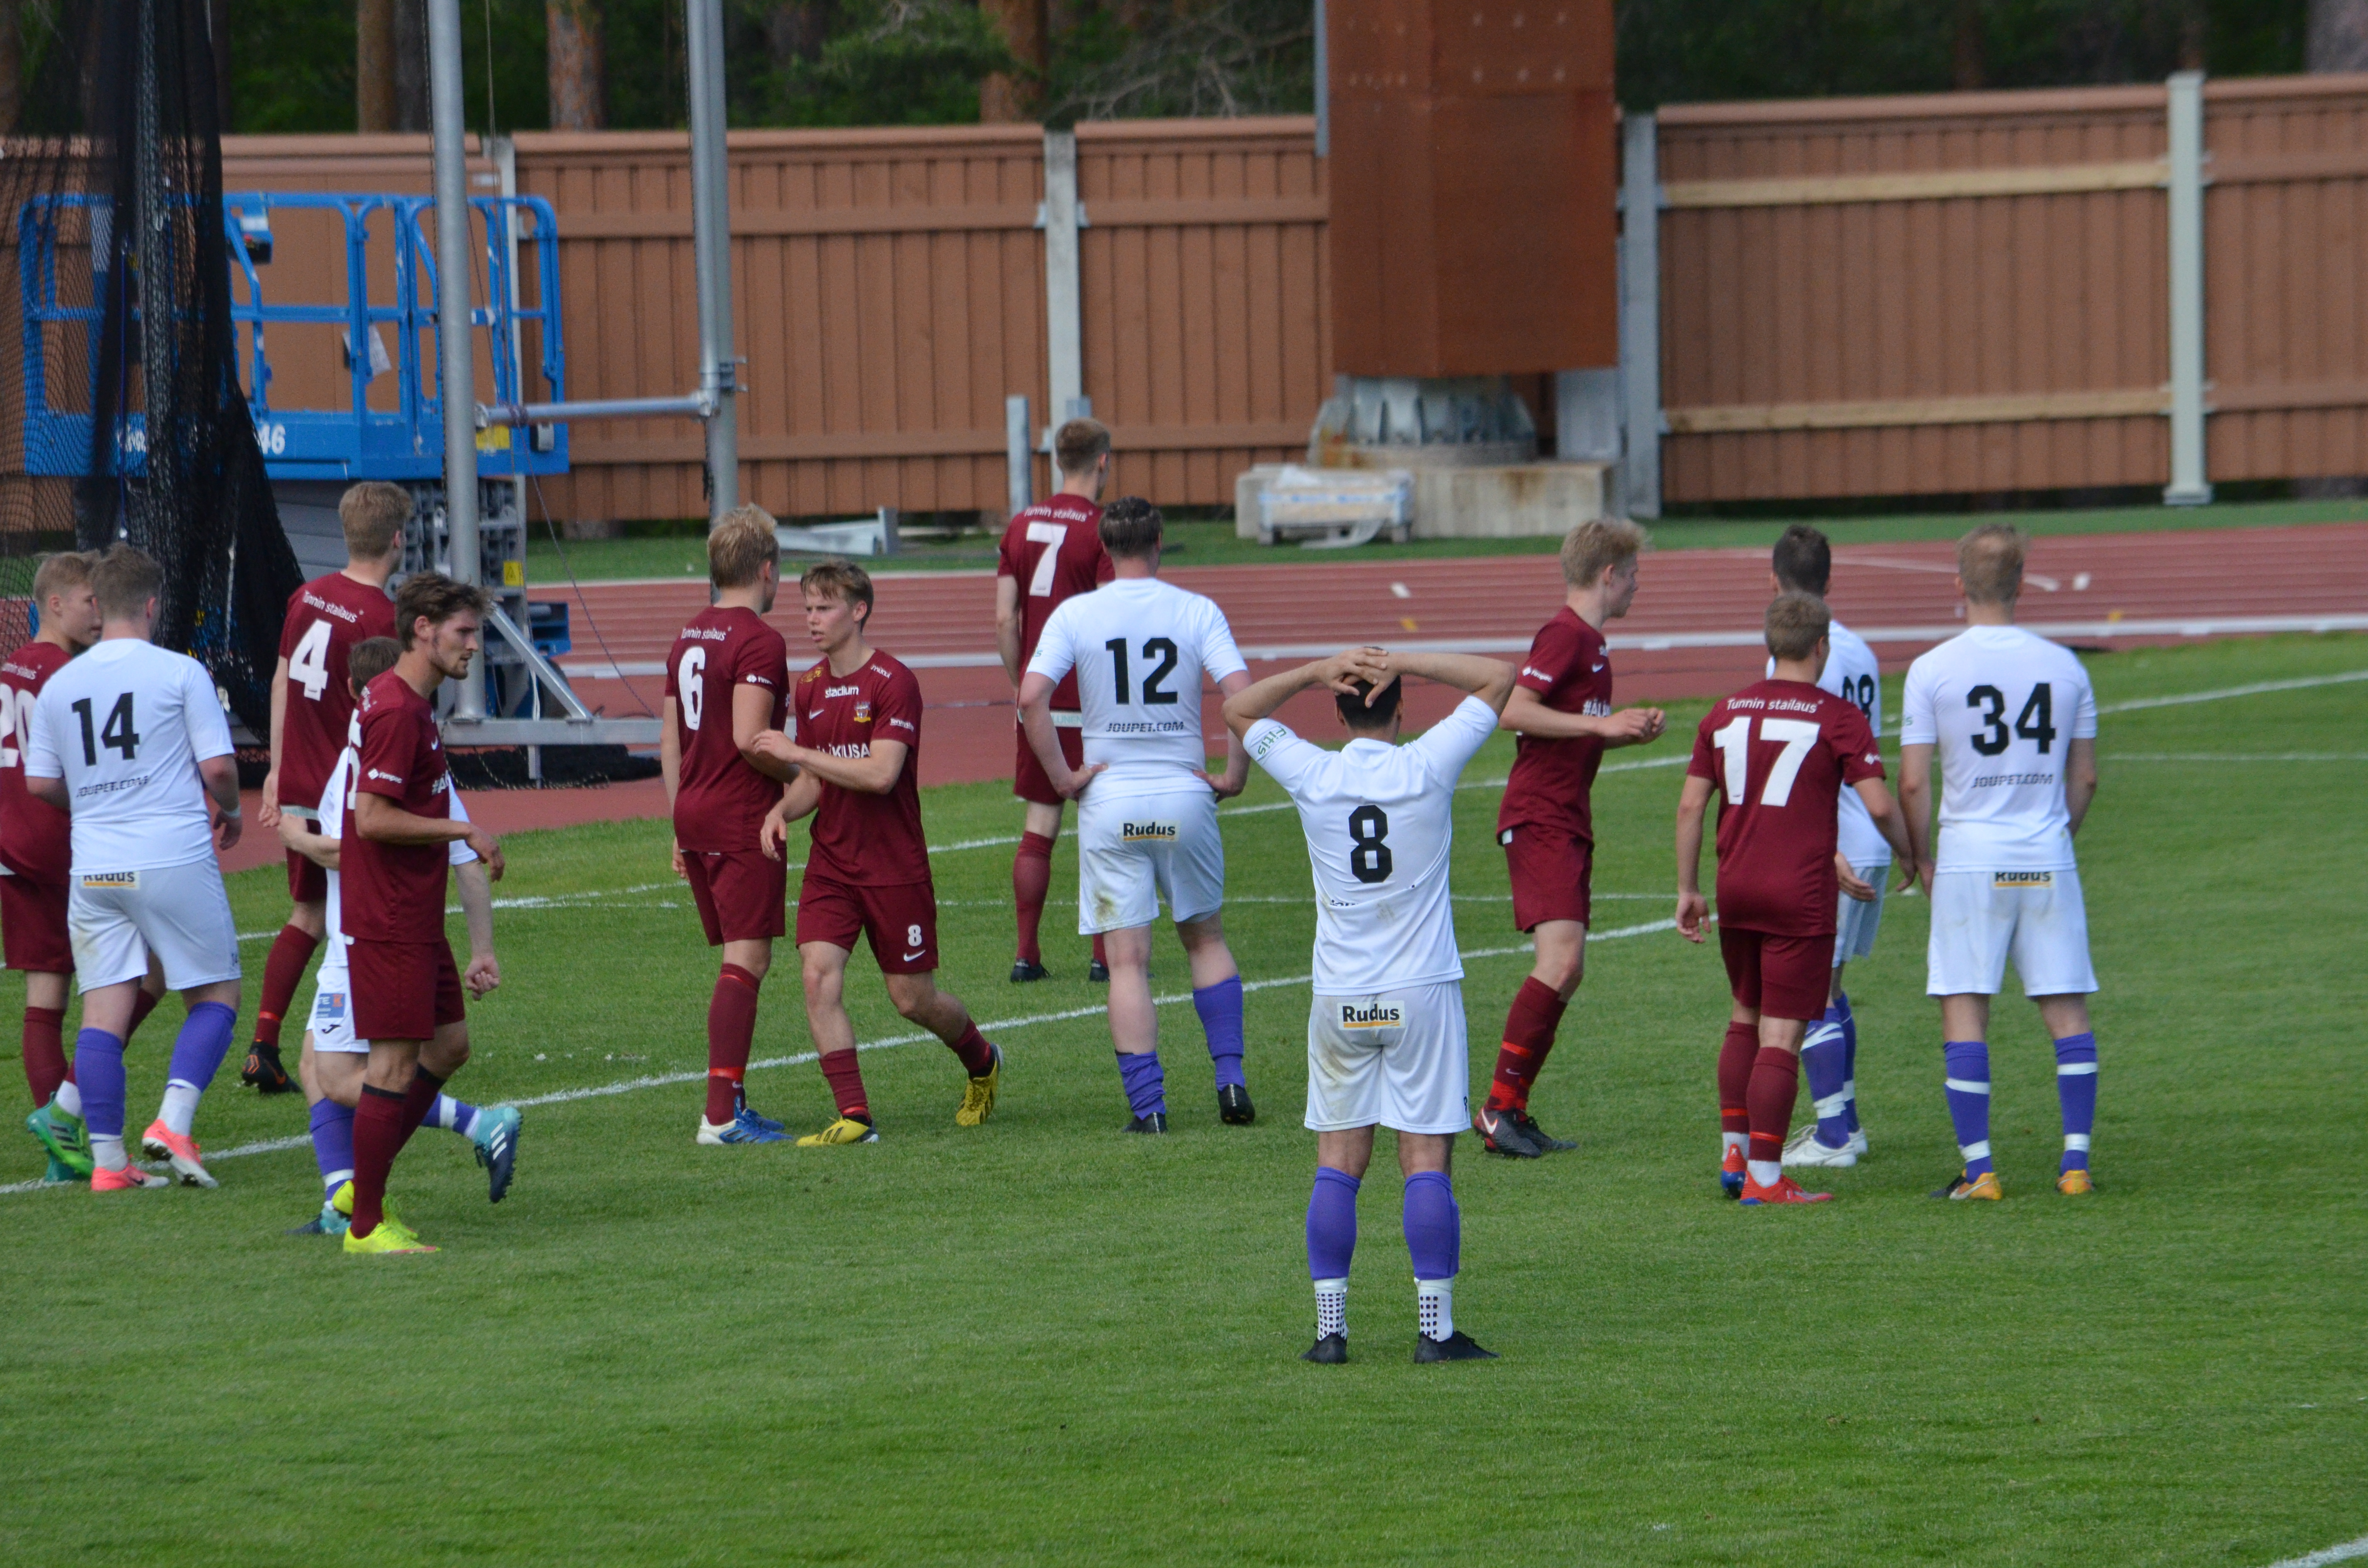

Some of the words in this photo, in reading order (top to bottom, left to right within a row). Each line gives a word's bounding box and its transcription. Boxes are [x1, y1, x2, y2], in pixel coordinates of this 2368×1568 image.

[1026, 521, 1067, 597] 7
[289, 619, 332, 701] 4
[678, 646, 705, 730] 6
[825, 686, 860, 698] stadium
[1106, 637, 1178, 705] 12
[72, 692, 140, 767] 14
[1106, 722, 1184, 733] JOUPET.COM
[1727, 698, 1765, 710] Tunnin
[1767, 699, 1817, 713] stailaus
[1967, 683, 2056, 757] 34
[1714, 716, 1821, 807] 17
[1971, 774, 2053, 788] JOUPET.COM
[1123, 821, 1175, 836] Rudus
[1348, 805, 1393, 883] 8
[908, 925, 922, 946] 8
[1343, 1003, 1400, 1023] Rudus
